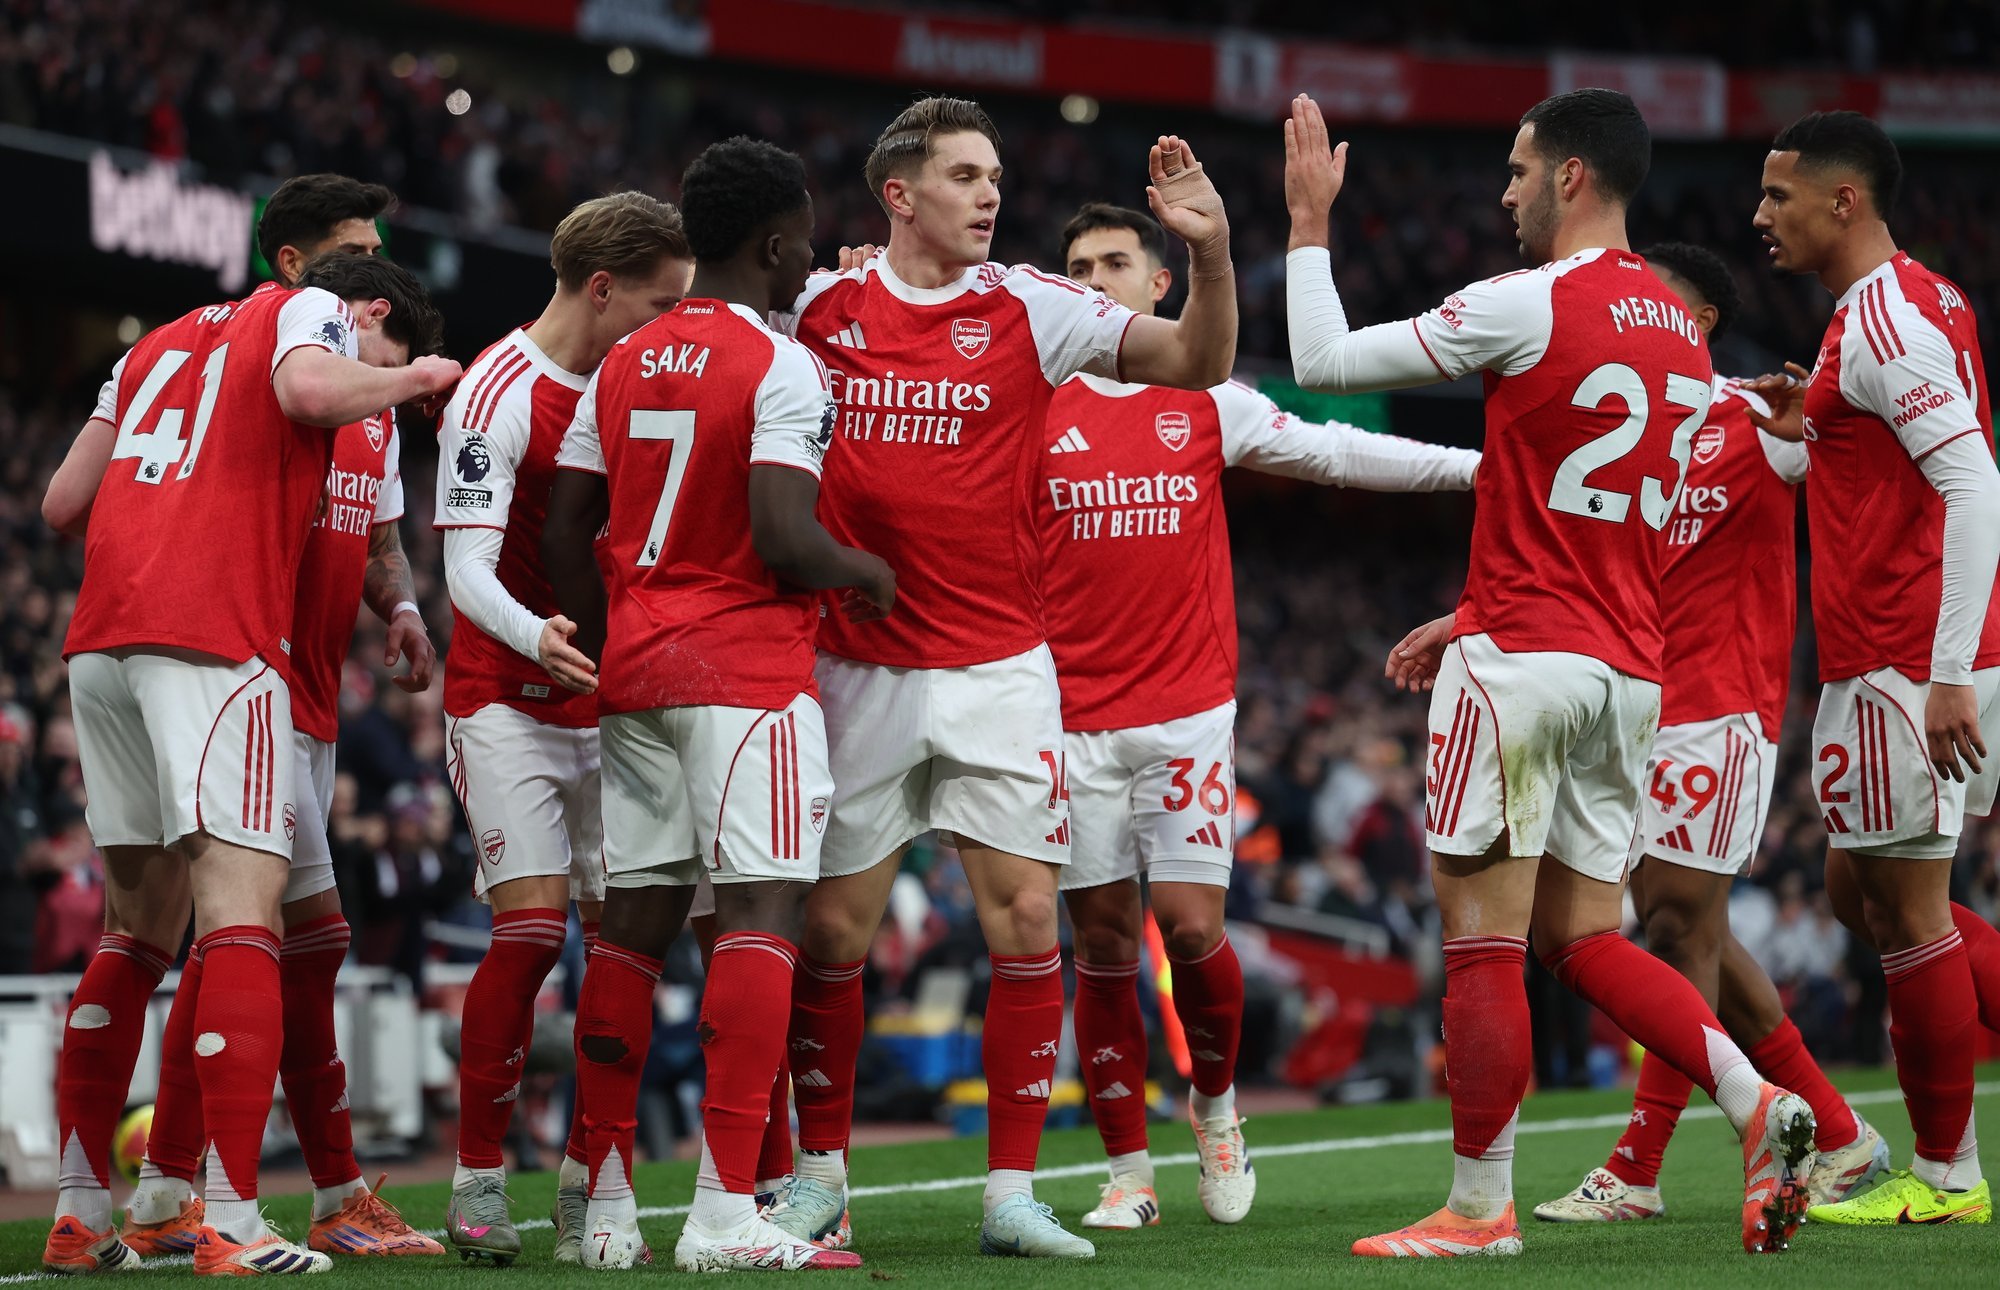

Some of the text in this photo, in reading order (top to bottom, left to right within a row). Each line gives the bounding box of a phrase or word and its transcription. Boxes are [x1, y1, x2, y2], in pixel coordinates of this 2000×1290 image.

[1617, 257, 1642, 271] Arsenal
[683, 304, 715, 315] Arsenal
[1608, 297, 1699, 347] MERINO
[957, 325, 985, 334] Arsenal
[640, 343, 711, 379] SAKA
[827, 368, 991, 412] Emirates
[1894, 382, 1933, 409] VISIT
[111, 341, 230, 485] 41
[1893, 390, 1956, 429] RWANDA
[844, 411, 963, 446] FLY BETTER
[1547, 362, 1712, 532] 23
[448, 489, 487, 500] No room
[459, 499, 491, 509] racism
[628, 408, 697, 567] 7
[1048, 471, 1199, 512] Emirates
[332, 502, 371, 537] BETTER
[1073, 507, 1181, 541] FLY BETTER
[1163, 757, 1229, 817] 36
[1649, 759, 1719, 821] 49
[1818, 743, 1851, 803] 2
[593, 1231, 612, 1262] 7
